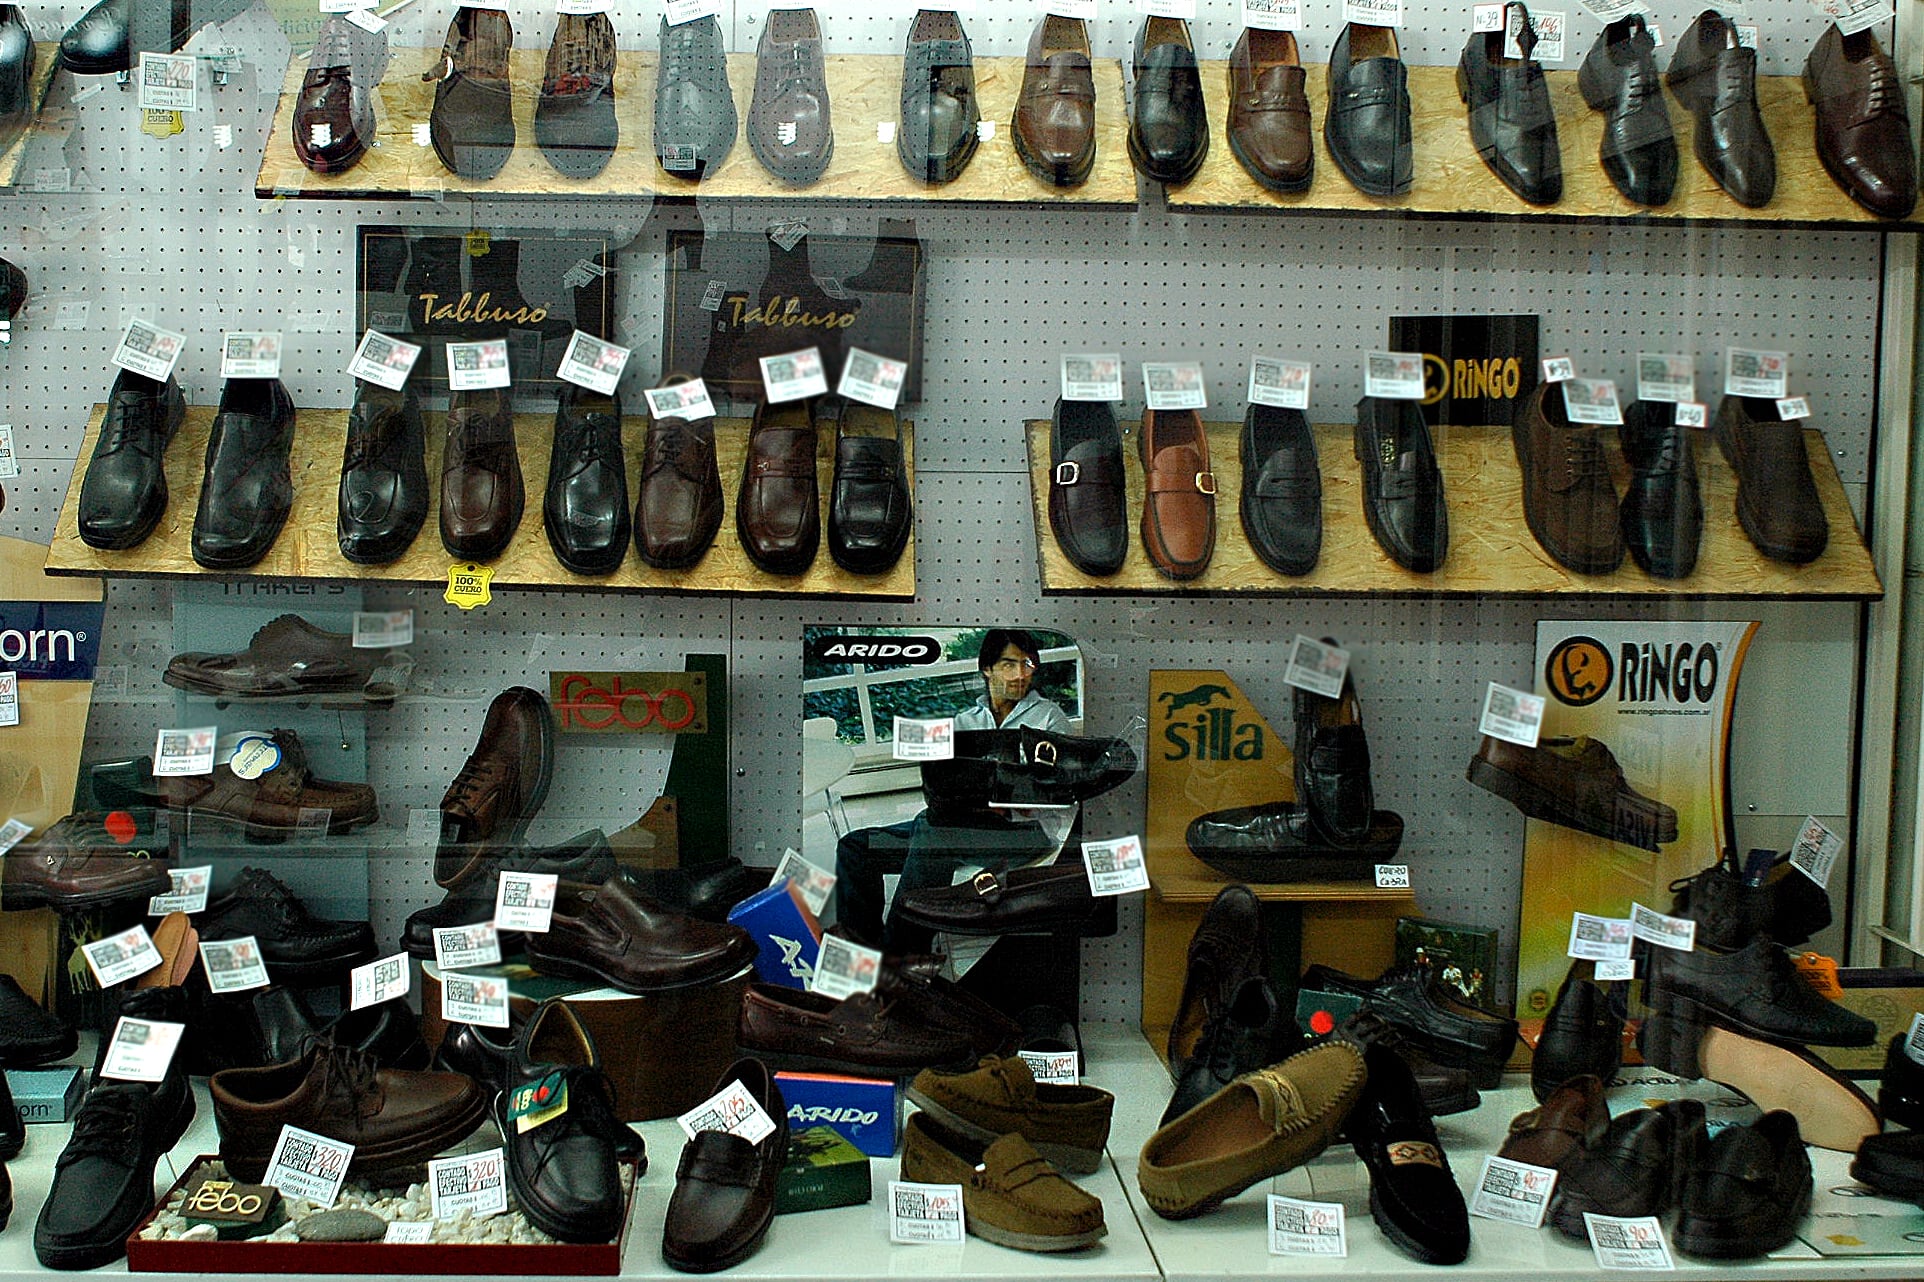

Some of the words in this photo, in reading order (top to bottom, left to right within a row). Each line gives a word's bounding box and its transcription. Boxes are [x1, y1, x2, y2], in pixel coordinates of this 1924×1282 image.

[419, 291, 548, 324] Tabbuso
[727, 295, 857, 328] Tabbuso
[454, 585, 482, 593] CUERO
[455, 576, 482, 585] 100%
[824, 644, 928, 658] ARIDO
[553, 674, 695, 729] febo
[1164, 707, 1263, 761] silla
[787, 1104, 878, 1125] ARIDO
[188, 1185, 262, 1215] febo
